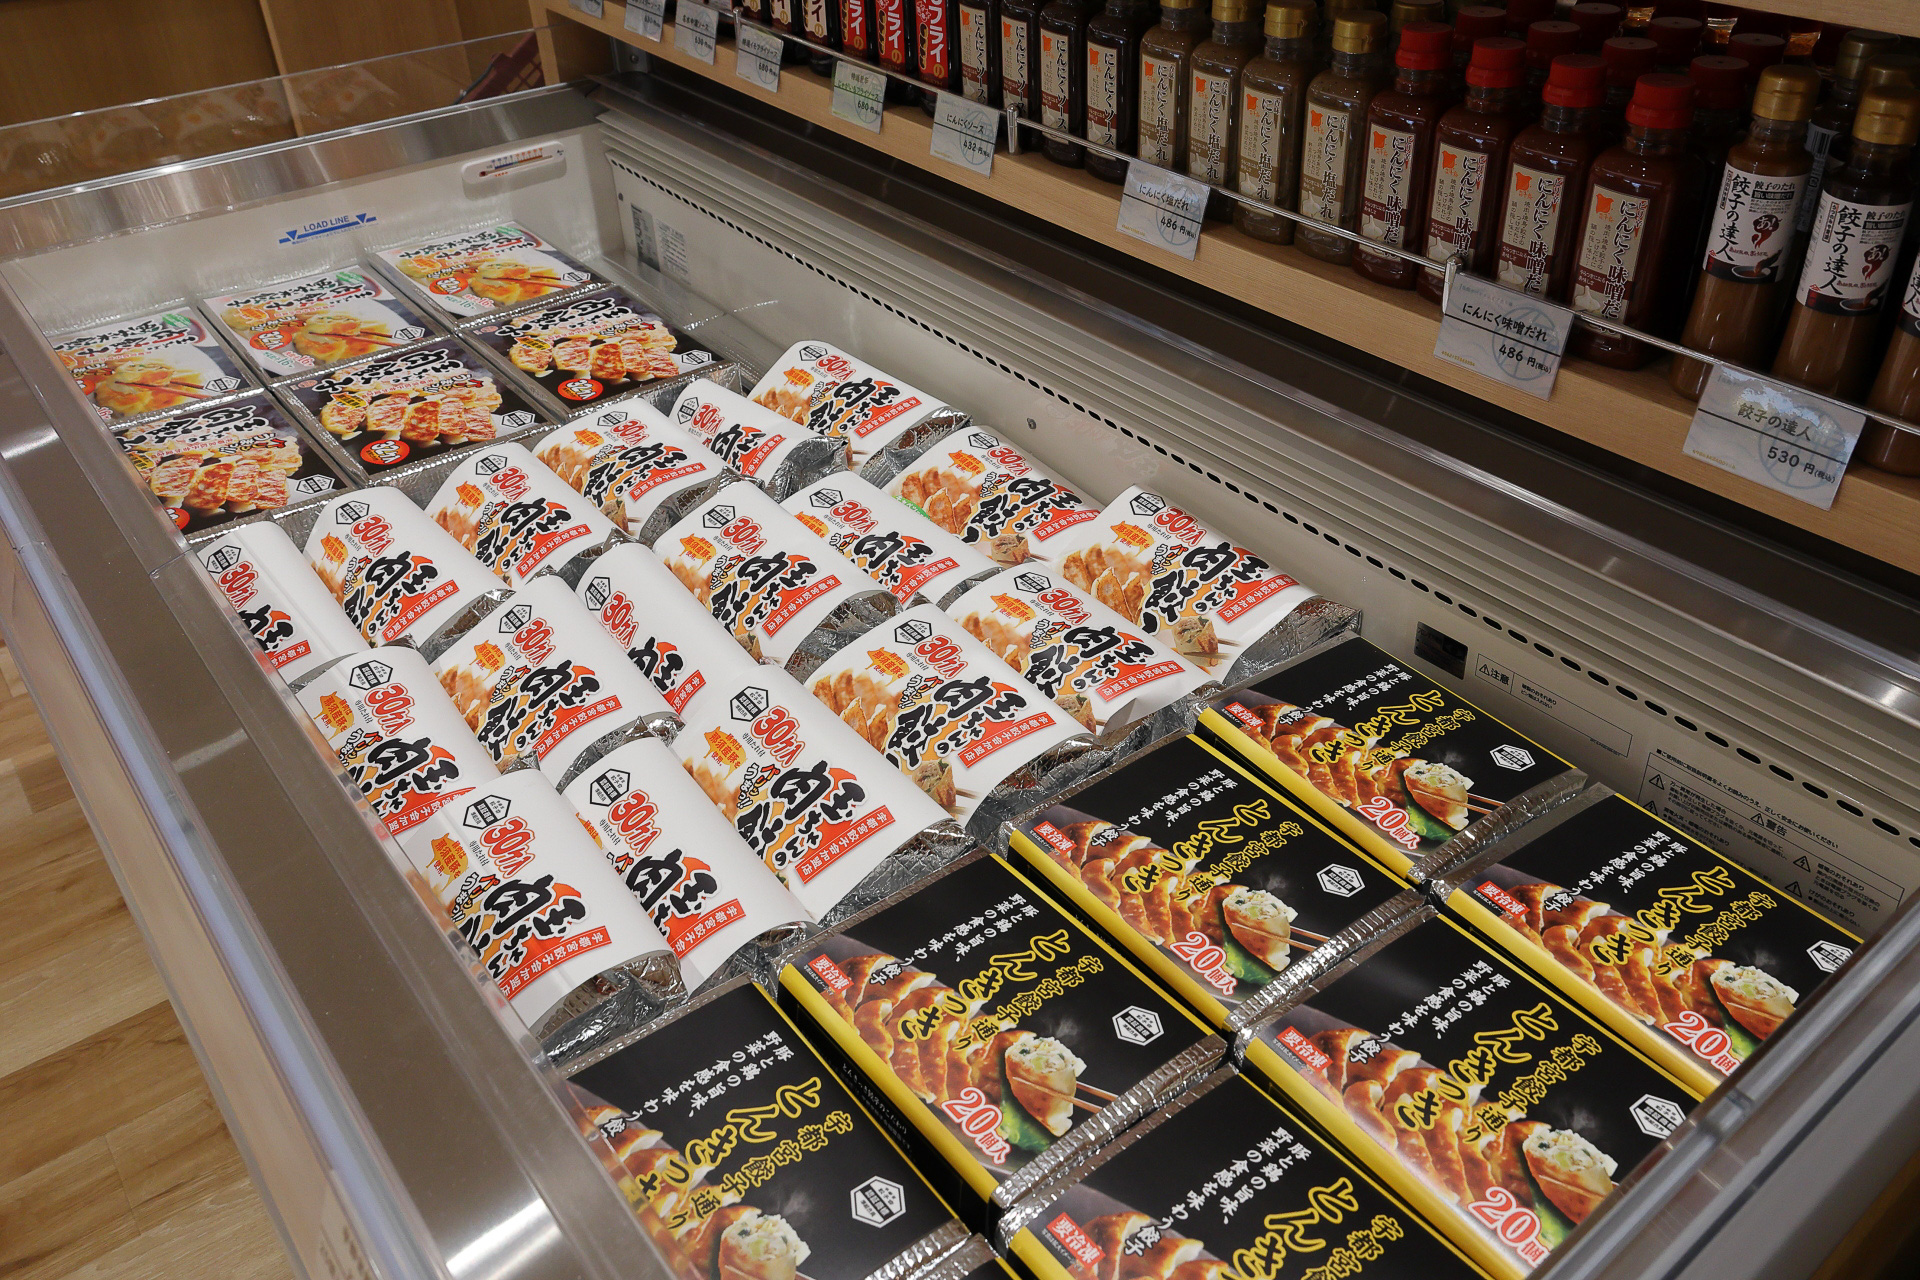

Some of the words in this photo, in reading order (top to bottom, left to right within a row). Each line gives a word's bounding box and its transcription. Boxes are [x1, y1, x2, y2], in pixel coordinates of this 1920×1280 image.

[974, 14, 986, 100] にんにくソース
[1056, 39, 1067, 130] にんにくソース
[858, 101, 869, 111] 680
[947, 114, 984, 133] にんにくソース
[1104, 53, 1116, 146] にんにくソース
[1157, 65, 1170, 162] にんにく塩だれ
[1207, 81, 1221, 180] にんにく塩だれ
[963, 140, 976, 152] 432
[1257, 98, 1273, 201] にんにく塩だれ
[1321, 114, 1338, 220] にんにく塩だれ
[303, 220, 328, 232] LOAD
[330, 215, 350, 226] LINE
[1140, 184, 1189, 211] にんにく塩だれ
[1161, 216, 1177, 230] 486
[1716, 174, 1751, 262] 餃子の達人
[1820, 205, 1863, 295] 餃子の達人
[1462, 303, 1547, 342] にんにく味噌だれ
[1499, 344, 1523, 362] 486
[1738, 402, 1811, 442] 餃子の達人
[1767, 446, 1800, 468] 530
[1230, 702, 1265, 729] 要冷凍
[1279, 662, 1396, 727] 野菜の食感を味わう餃子
[1490, 667, 1510, 686] 注意
[1309, 688, 1445, 766] とんきっき
[1360, 708, 1476, 772] 宇都宮餃子通り
[1034, 821, 1074, 852] 要冷凍
[1089, 768, 1223, 848] 野菜の食感を味わう餃子
[1120, 798, 1271, 895] とんきっき
[1356, 795, 1422, 850] 20個入
[1766, 818, 1788, 837] 警告
[1175, 820, 1304, 902] 宇都宮餃子通り
[1479, 882, 1527, 917] 要冷凍
[1543, 830, 1672, 913] 野菜の食感を味わう餃子
[868, 893, 1024, 987] 野菜の食感を味わう餃子
[1589, 865, 1736, 968] とんきっき
[1654, 890, 1778, 978] 宇都宮餃子通り
[810, 954, 854, 994] 要冷凍
[897, 928, 1072, 1043] とんきっき
[952, 953, 1105, 1051] 宇都宮餃子通り
[1169, 931, 1239, 996] 20個入
[1280, 1026, 1333, 1071] 要冷凍
[1348, 959, 1495, 1064] 野菜の食感を味わう餃子
[1663, 1010, 1743, 1077] 20個
[600, 1029, 780, 1139] 野菜の食感を味わう餃
[1394, 1002, 1560, 1132] とんきっき
[1461, 1033, 1603, 1144] 宇都宮餃子通り
[942, 1086, 1011, 1164] 20個入
[666, 1110, 854, 1232] 宇都宮餃子通り
[1124, 1126, 1294, 1258] 野菜の食感を味わう餃子
[1050, 1212, 1107, 1269] 要冷凍
[1468, 1186, 1548, 1268] 20個
